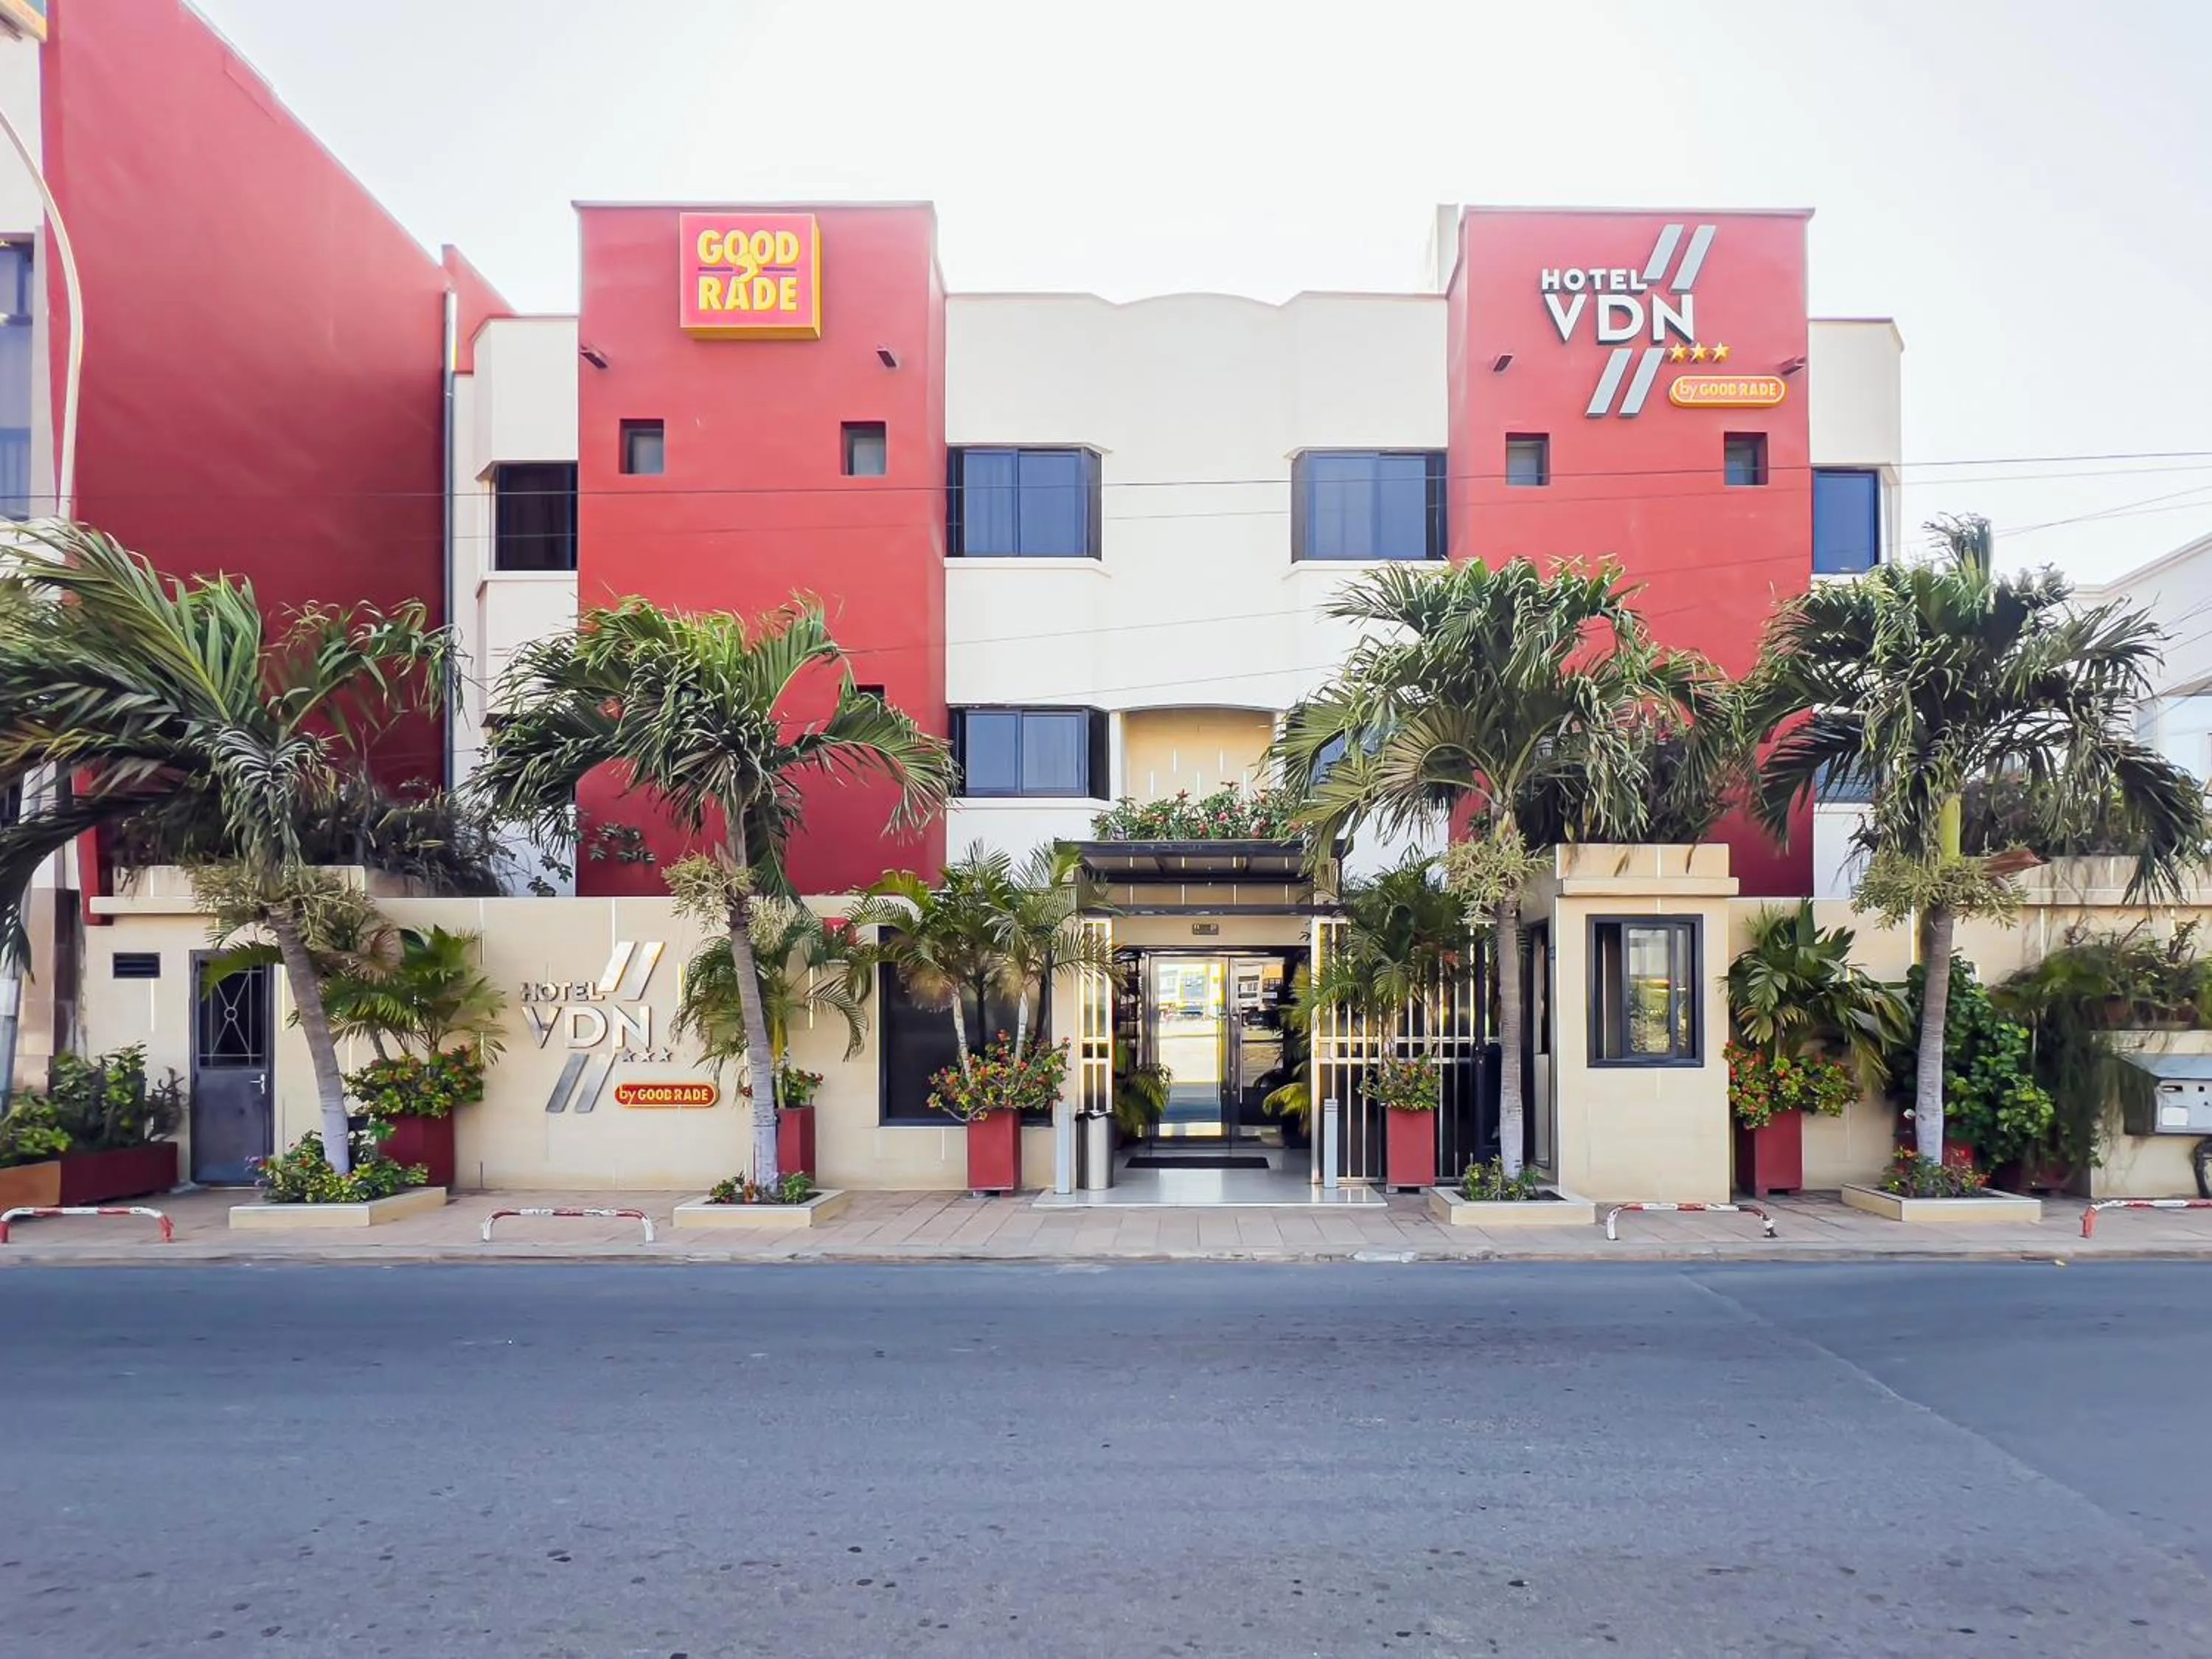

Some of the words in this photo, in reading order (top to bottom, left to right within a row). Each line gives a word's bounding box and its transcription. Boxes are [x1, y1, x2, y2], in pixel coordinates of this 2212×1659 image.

[698, 229, 799, 265] GOOD
[698, 276, 798, 310] RADE
[1541, 268, 1648, 291] HOTEL
[1545, 293, 1694, 344] VDN
[1679, 379, 1696, 400] by
[1700, 383, 1737, 396] GOOD
[520, 981, 605, 1001] HOTEL
[521, 1005, 652, 1049] VDN
[619, 1085, 636, 1106] by
[638, 1088, 672, 1101] GOOD
[673, 1088, 709, 1101] RADE
